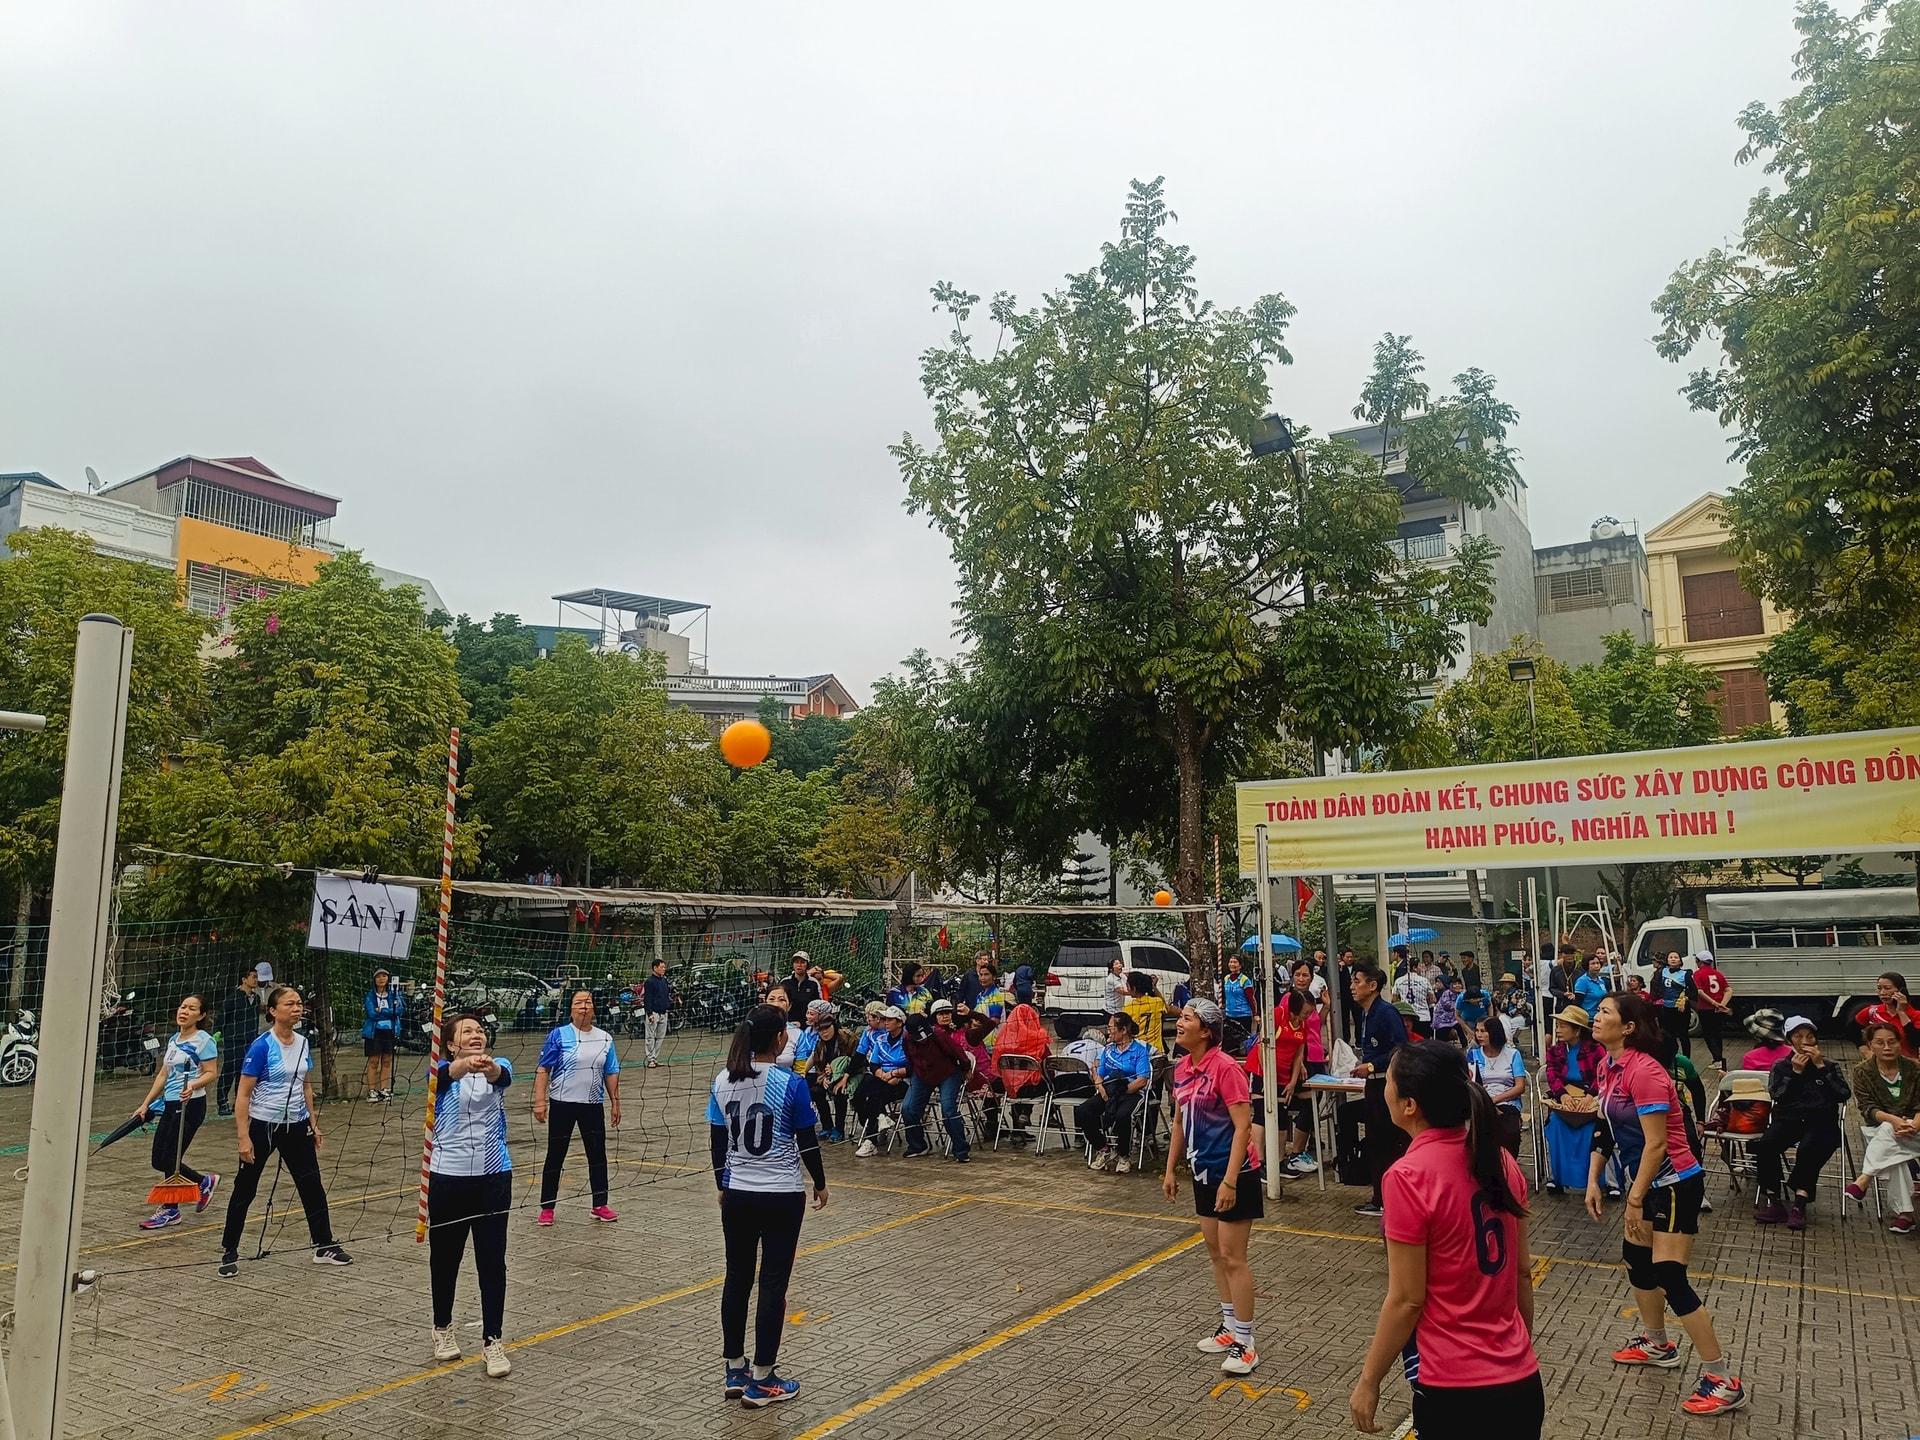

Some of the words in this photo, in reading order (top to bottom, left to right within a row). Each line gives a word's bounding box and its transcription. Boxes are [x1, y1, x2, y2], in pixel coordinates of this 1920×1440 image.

[1265, 796, 1318, 822] TOÀN
[1324, 792, 1366, 818] DÂN
[1372, 787, 1431, 816] ĐOÀN
[1438, 780, 1483, 812] KẾT,
[1488, 779, 1569, 807] CHUNG
[1577, 772, 1627, 801] SỨC
[1634, 768, 1684, 797] XÂY
[1692, 764, 1768, 798] DỰNG
[1776, 757, 1857, 793] CỘNG
[1425, 824, 1488, 854] HẠNH
[1493, 817, 1565, 847] PHÚC,
[1571, 811, 1650, 842] NGHĨA
[1655, 808, 1718, 838] TÌNH
[1726, 809, 1736, 835] !
[320, 894, 386, 930] SÂN
[394, 909, 406, 934] 1
[1708, 974, 1720, 994] 5
[1140, 1012, 1152, 1035] 7
[1070, 1042, 1086, 1055] 2
[725, 1100, 774, 1157] 10
[1471, 1190, 1507, 1277] 6
